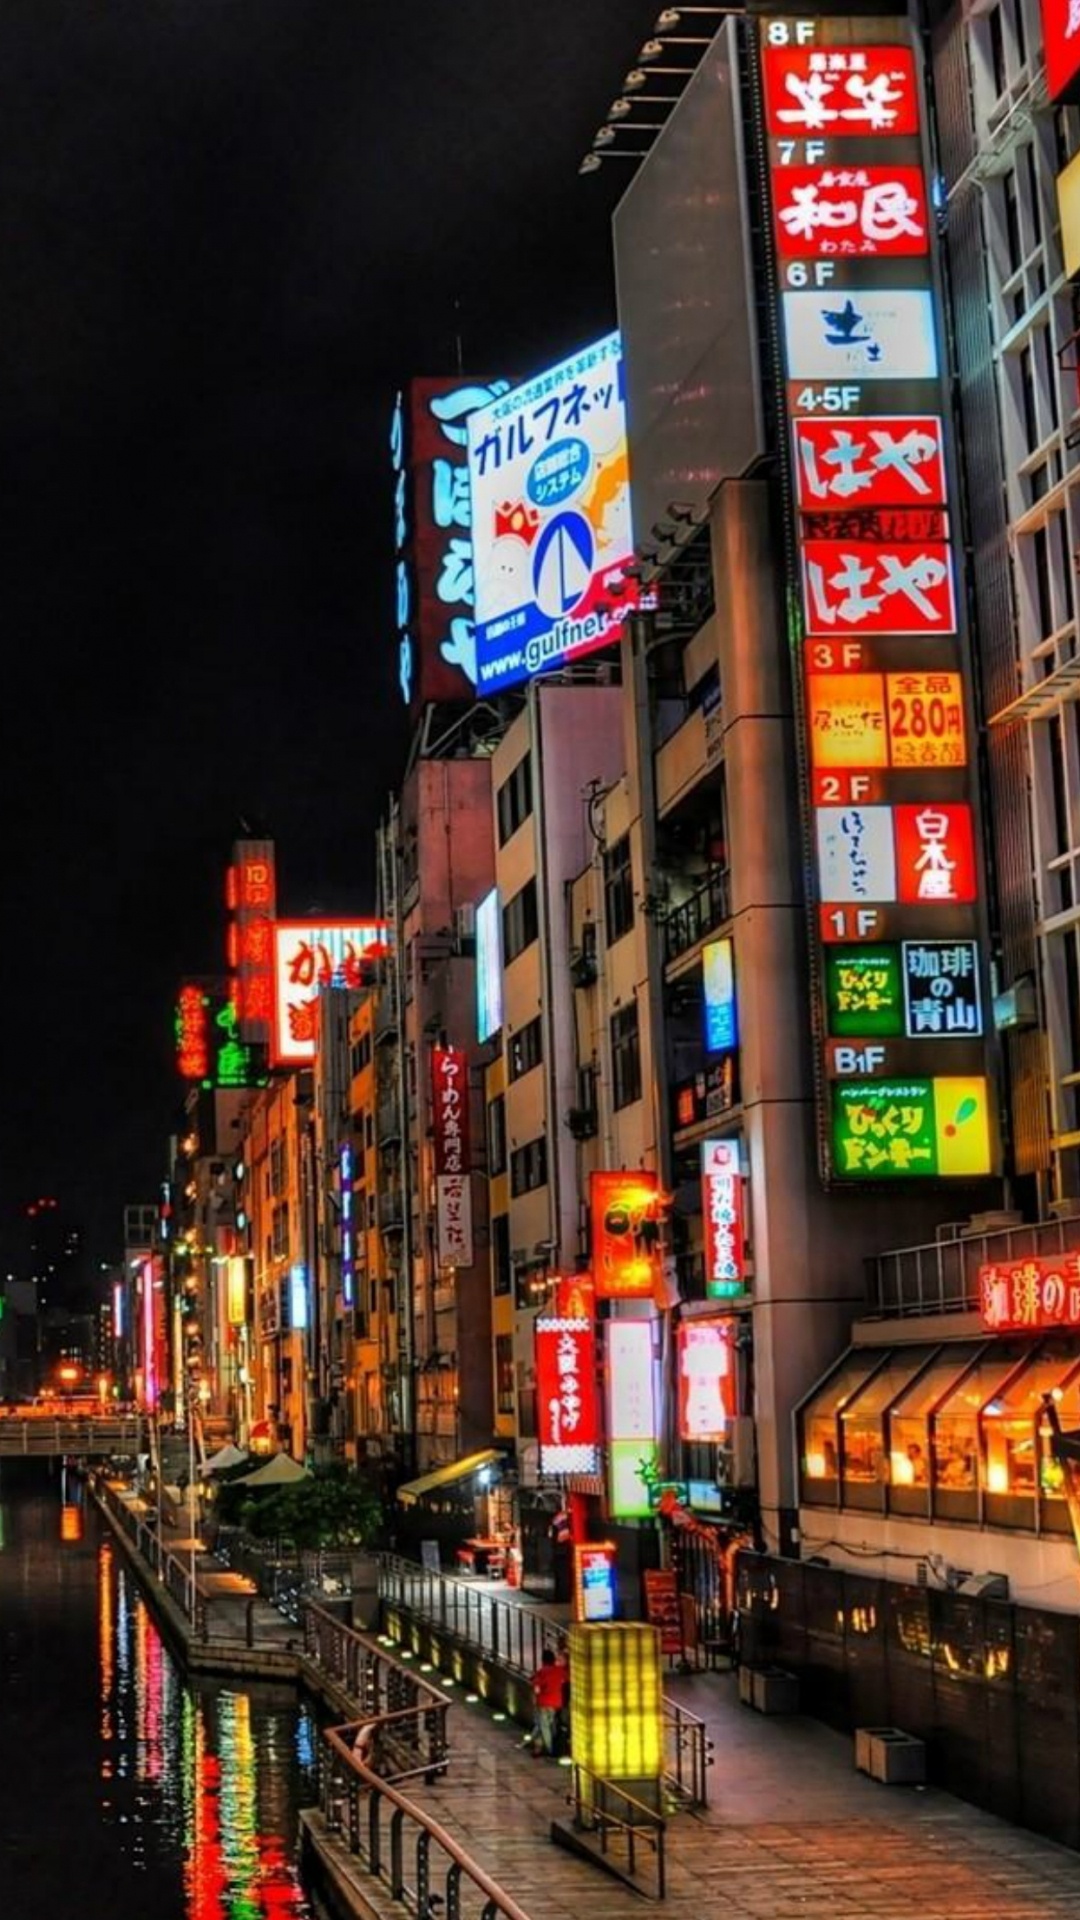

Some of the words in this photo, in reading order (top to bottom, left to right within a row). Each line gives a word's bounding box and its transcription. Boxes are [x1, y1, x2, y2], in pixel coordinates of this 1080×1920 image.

[779, 182, 923, 240] 和民
[820, 240, 877, 253] わたみ
[800, 429, 938, 499] はや
[535, 466, 583, 502] システム
[808, 554, 947, 624] はや
[896, 677, 951, 694] 全品
[891, 699, 961, 738] 280円
[914, 809, 958, 899] 白木屋
[838, 967, 888, 989] びっくり
[908, 947, 973, 977] 珈琲
[836, 991, 892, 1011] ドンキー
[930, 978, 954, 997] の
[911, 998, 975, 1032] 青山
[834, 1046, 885, 1073] B1F
[441, 1045, 462, 1171] らーめん専門店
[844, 1103, 924, 1138] びっくり
[843, 1137, 932, 1171] ドンキー
